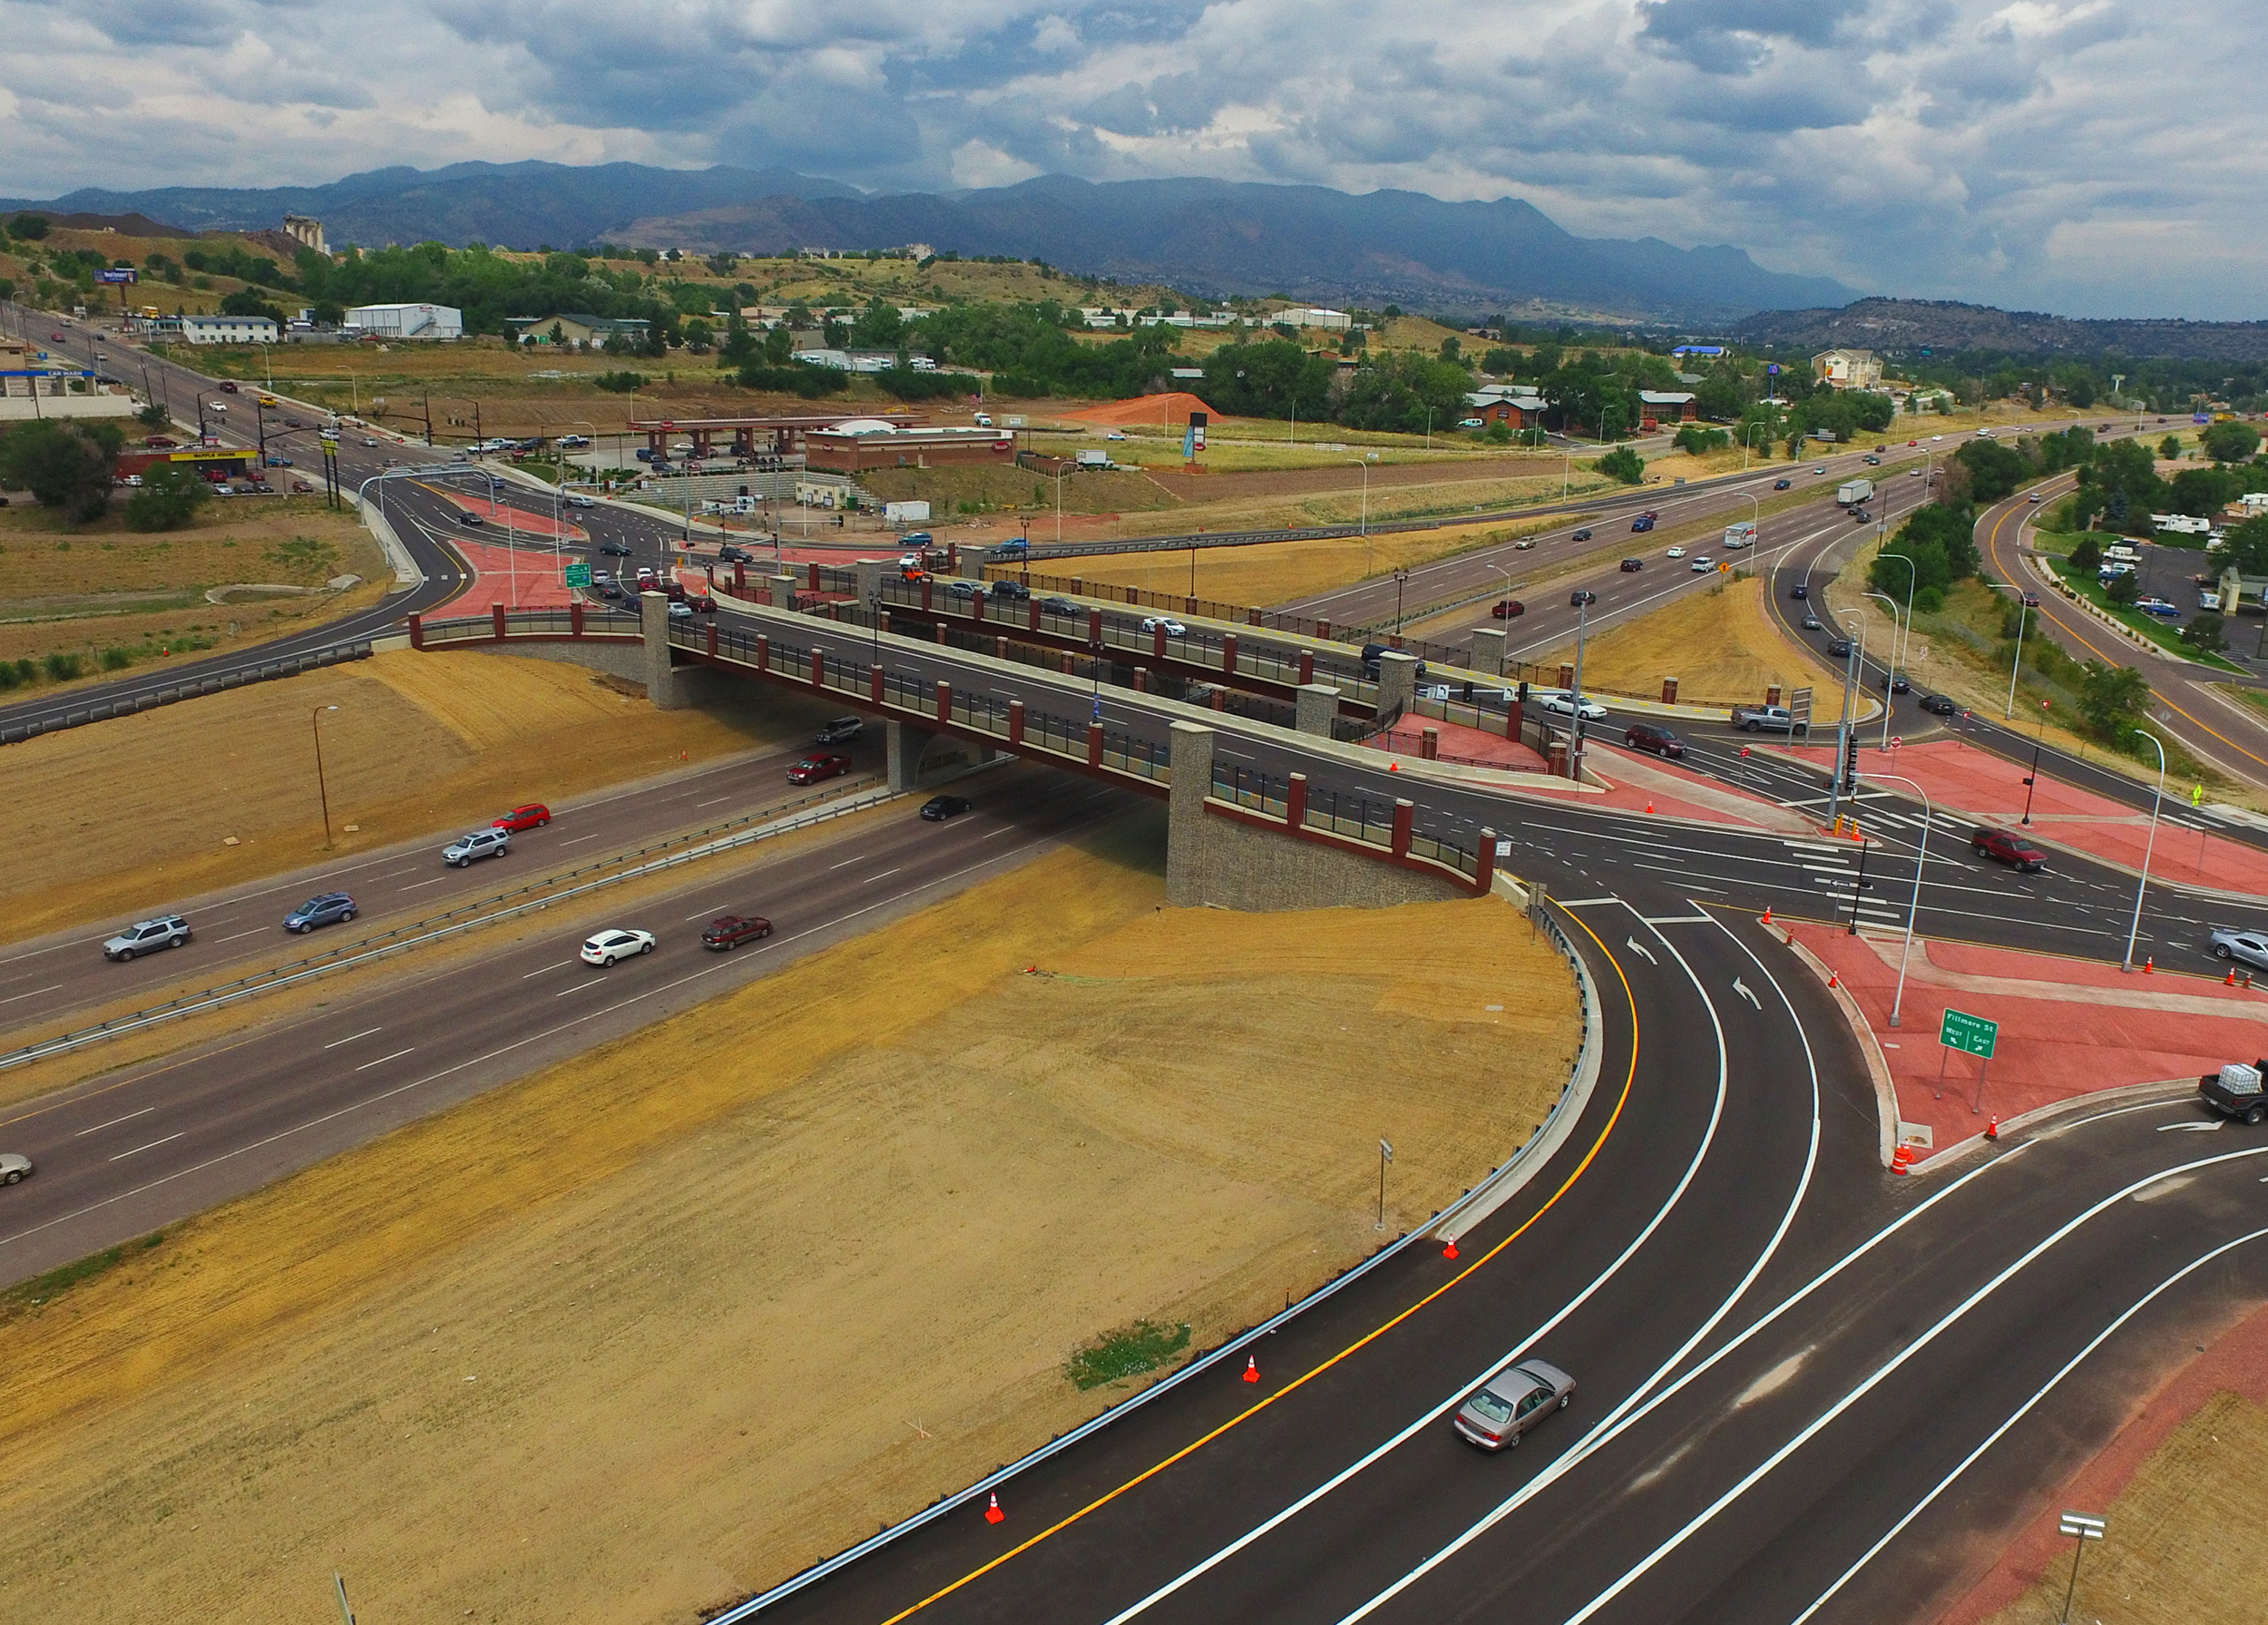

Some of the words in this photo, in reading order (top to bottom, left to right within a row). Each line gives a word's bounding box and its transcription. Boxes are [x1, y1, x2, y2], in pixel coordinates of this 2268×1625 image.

[1947, 1013, 1980, 1029] Fillmore
[1984, 1024, 1994, 1033] St
[1946, 1026, 1962, 1037] WEST
[1973, 1035, 1990, 1045] EAST
